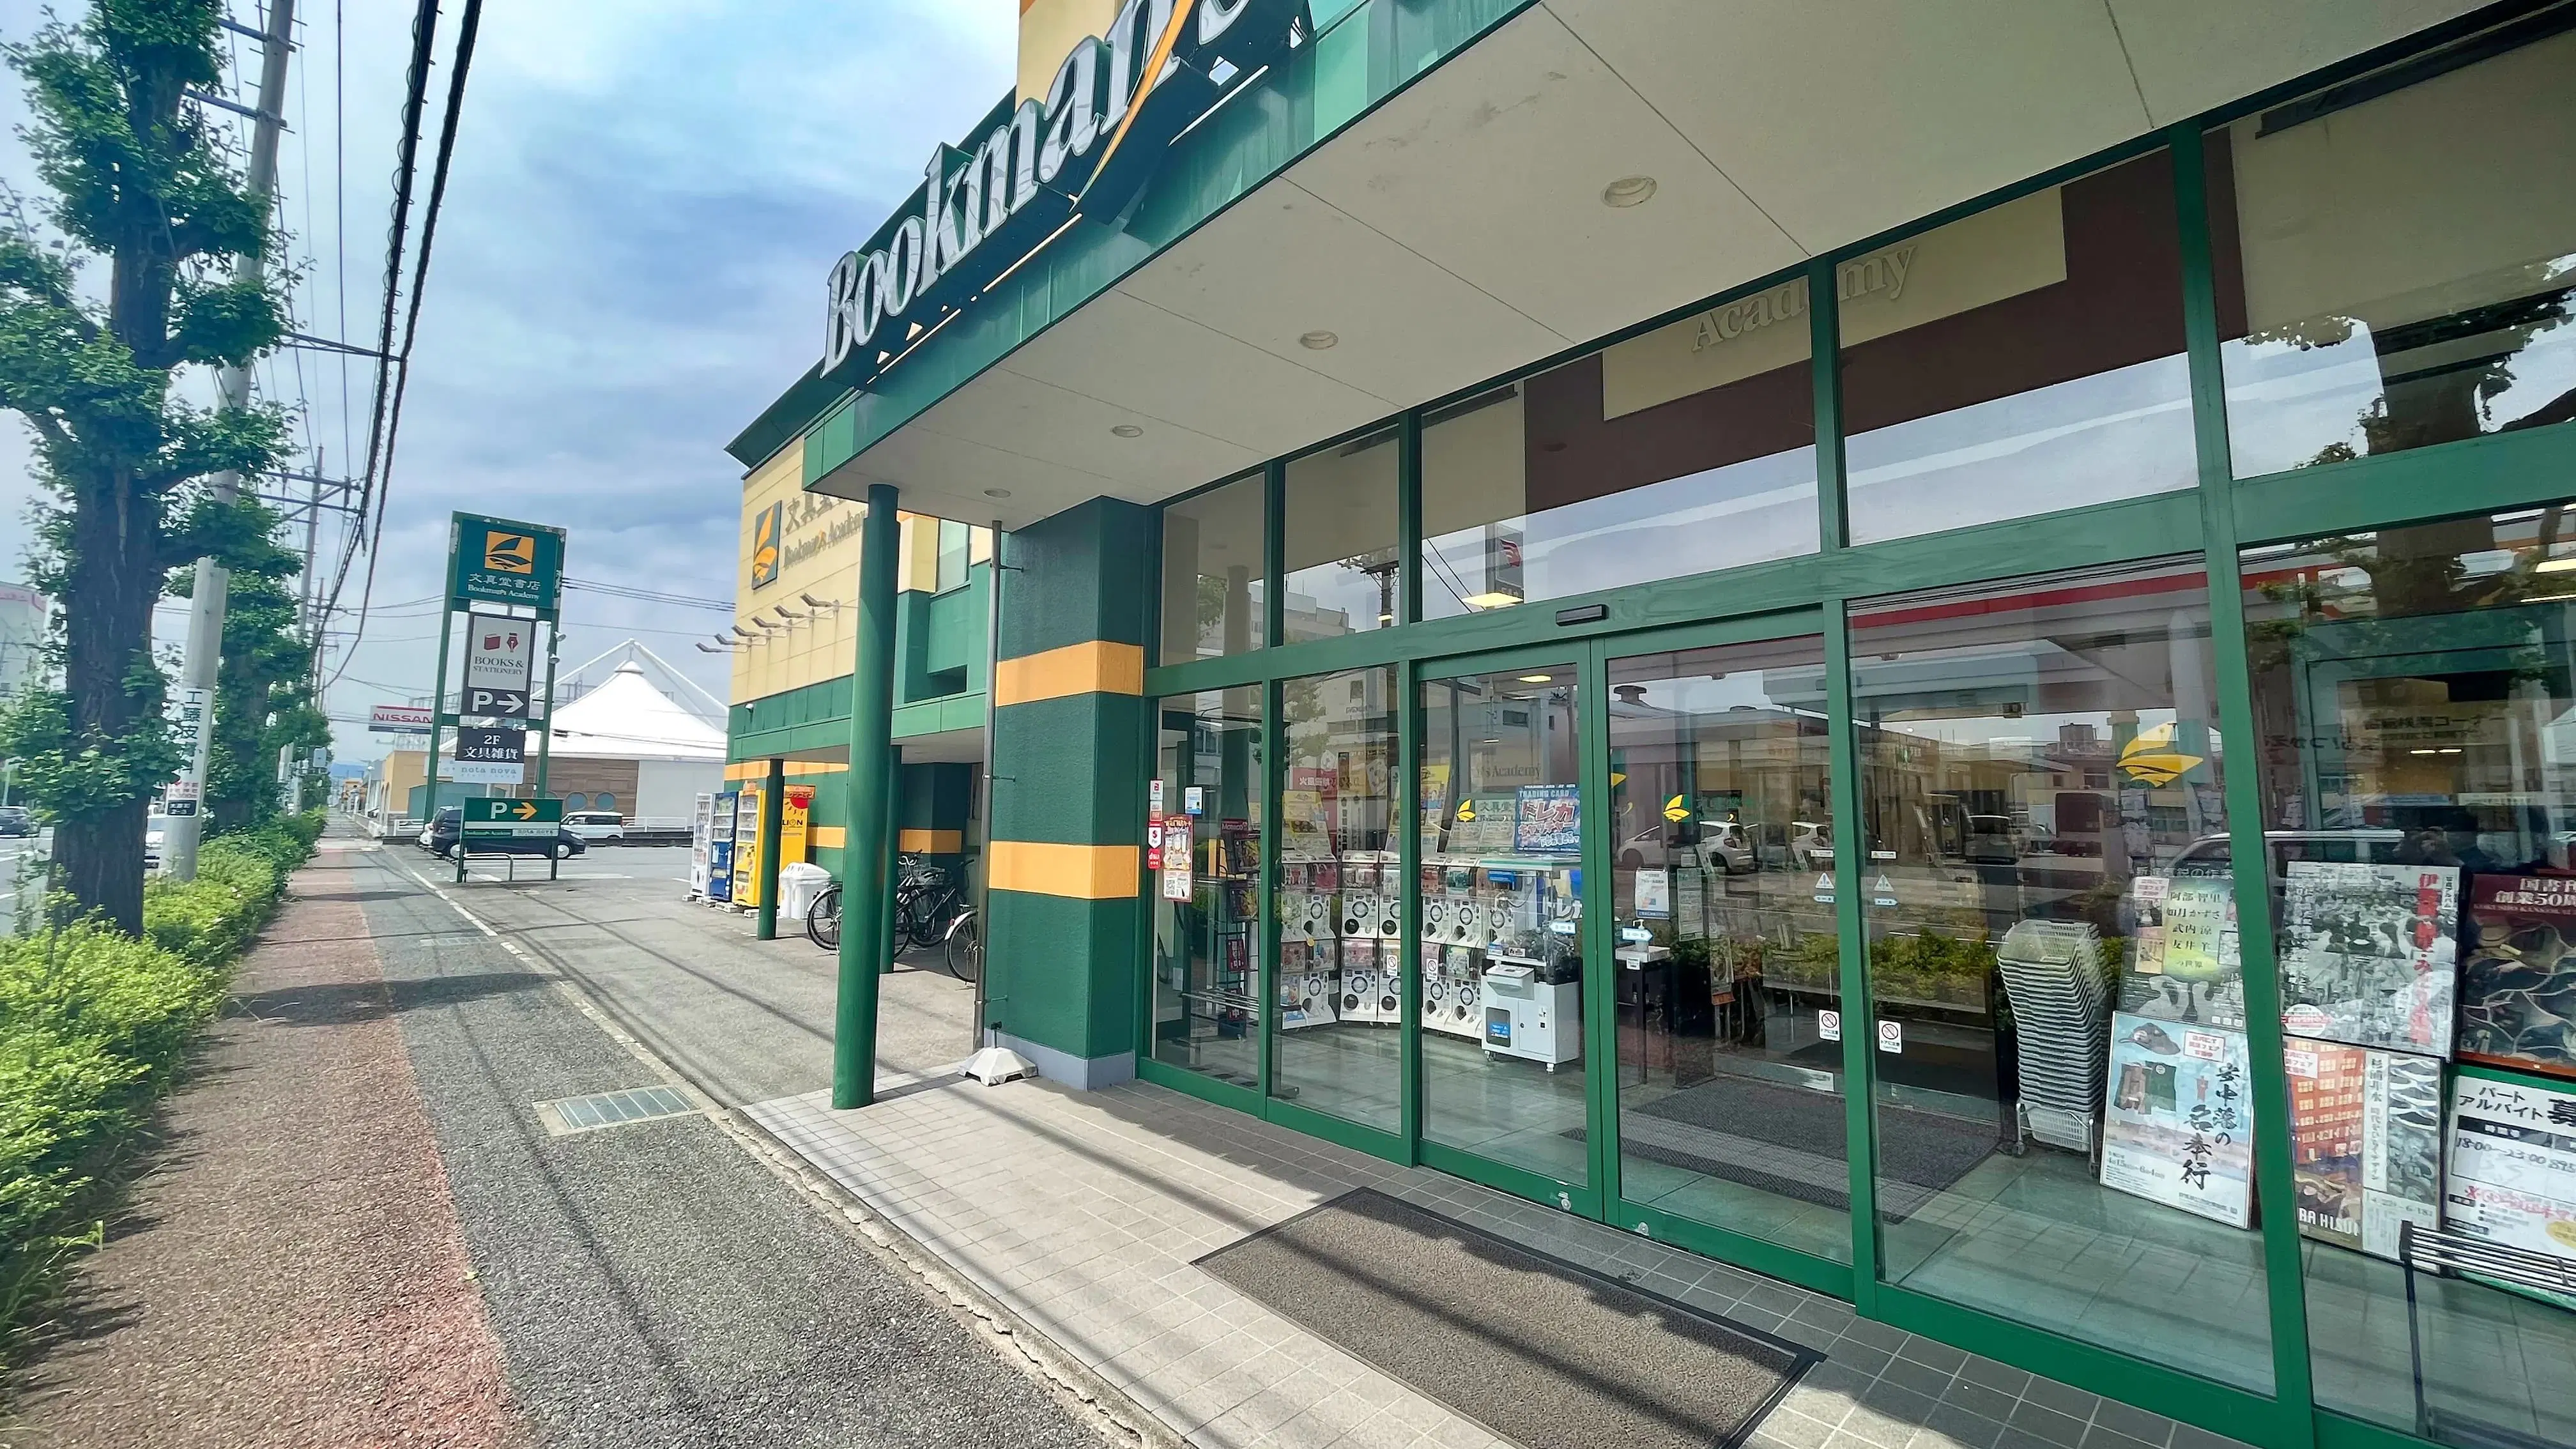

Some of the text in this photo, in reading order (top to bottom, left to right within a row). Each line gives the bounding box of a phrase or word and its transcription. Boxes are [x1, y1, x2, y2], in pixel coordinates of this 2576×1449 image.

[1691, 245, 1917, 353] Acadmy
[468, 573, 541, 591] 文真堂書店
[475, 656, 514, 668] BOOKS
[473, 666, 522, 675] STATIONERY
[471, 691, 493, 712] P
[373, 713, 434, 724] NISSAN
[484, 735, 501, 744] 2F
[463, 747, 518, 760] 文具雑貨
[491, 802, 507, 819] P
[2479, 1087, 2526, 1103] パート
[2460, 1095, 2543, 1120] アルバイト
